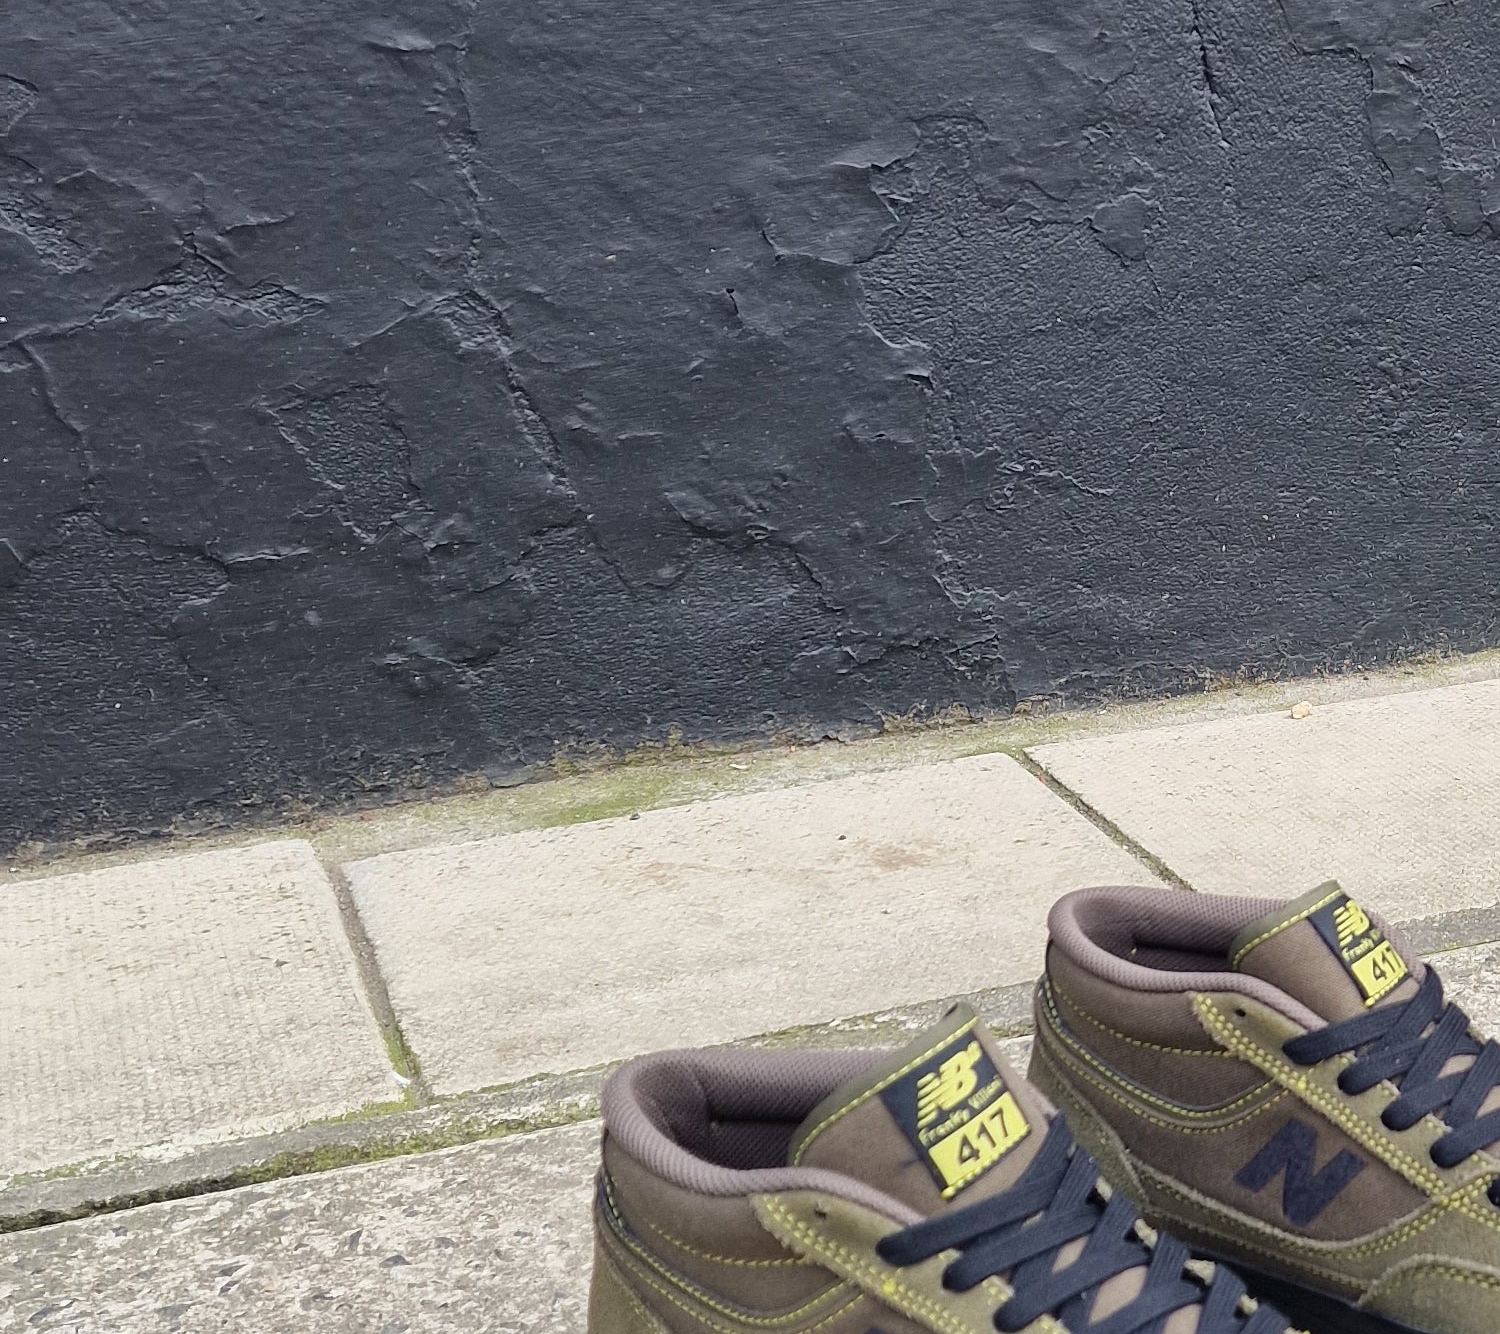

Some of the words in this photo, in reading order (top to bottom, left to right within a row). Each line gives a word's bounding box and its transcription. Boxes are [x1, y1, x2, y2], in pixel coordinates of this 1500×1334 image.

[1372, 946, 1403, 981] 417
[957, 1106, 1009, 1165] 417
[1233, 1119, 1367, 1228] N
